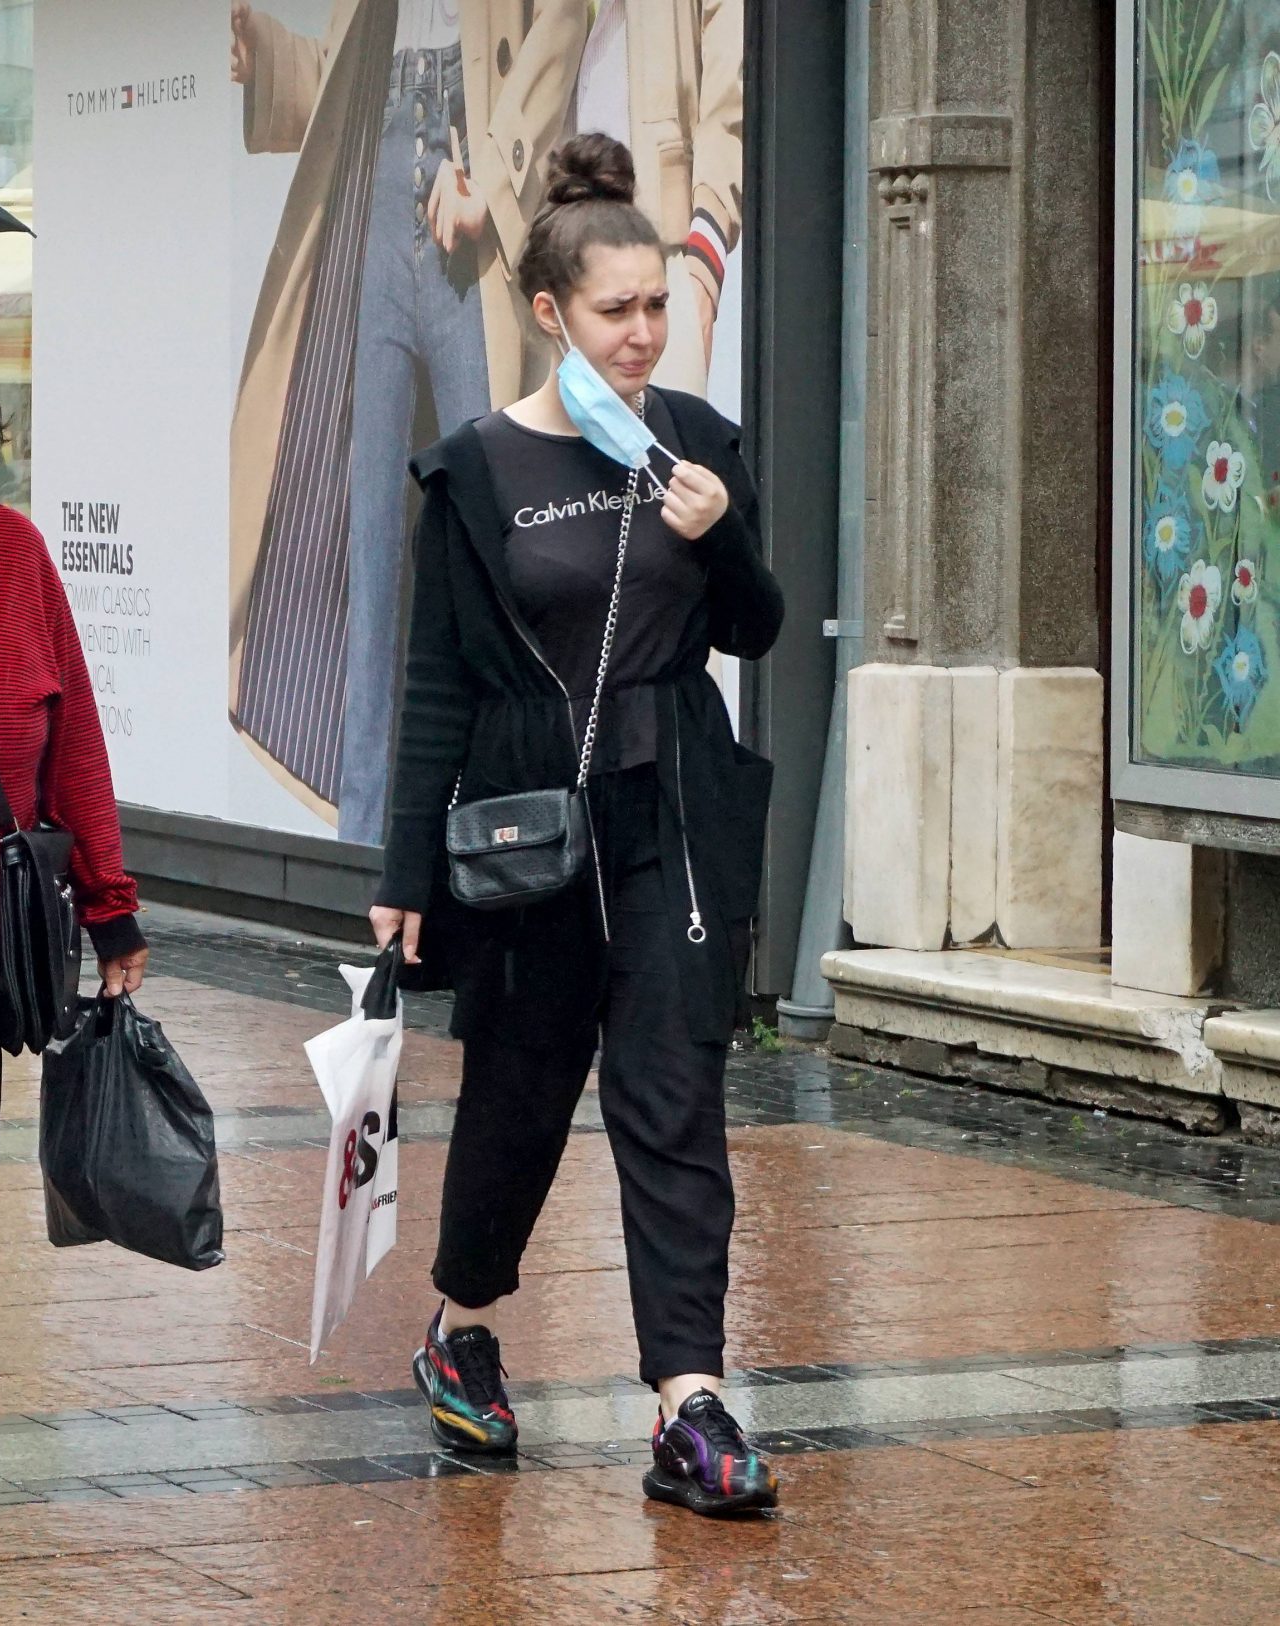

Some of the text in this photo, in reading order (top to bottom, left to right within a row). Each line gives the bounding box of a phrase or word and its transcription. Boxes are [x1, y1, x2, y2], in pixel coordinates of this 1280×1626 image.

[67, 74, 197, 117] TOMMY HILFIGER
[61, 501, 120, 534] THE NEW
[514, 497, 586, 528] Calvin
[642, 482, 666, 503] Je
[61, 540, 134, 576] ESSENTIALS
[62, 583, 151, 617] OMMY CLASSICS
[80, 623, 152, 657] VENTED WITH
[91, 663, 117, 695] ICAL
[99, 704, 134, 737] TIONS
